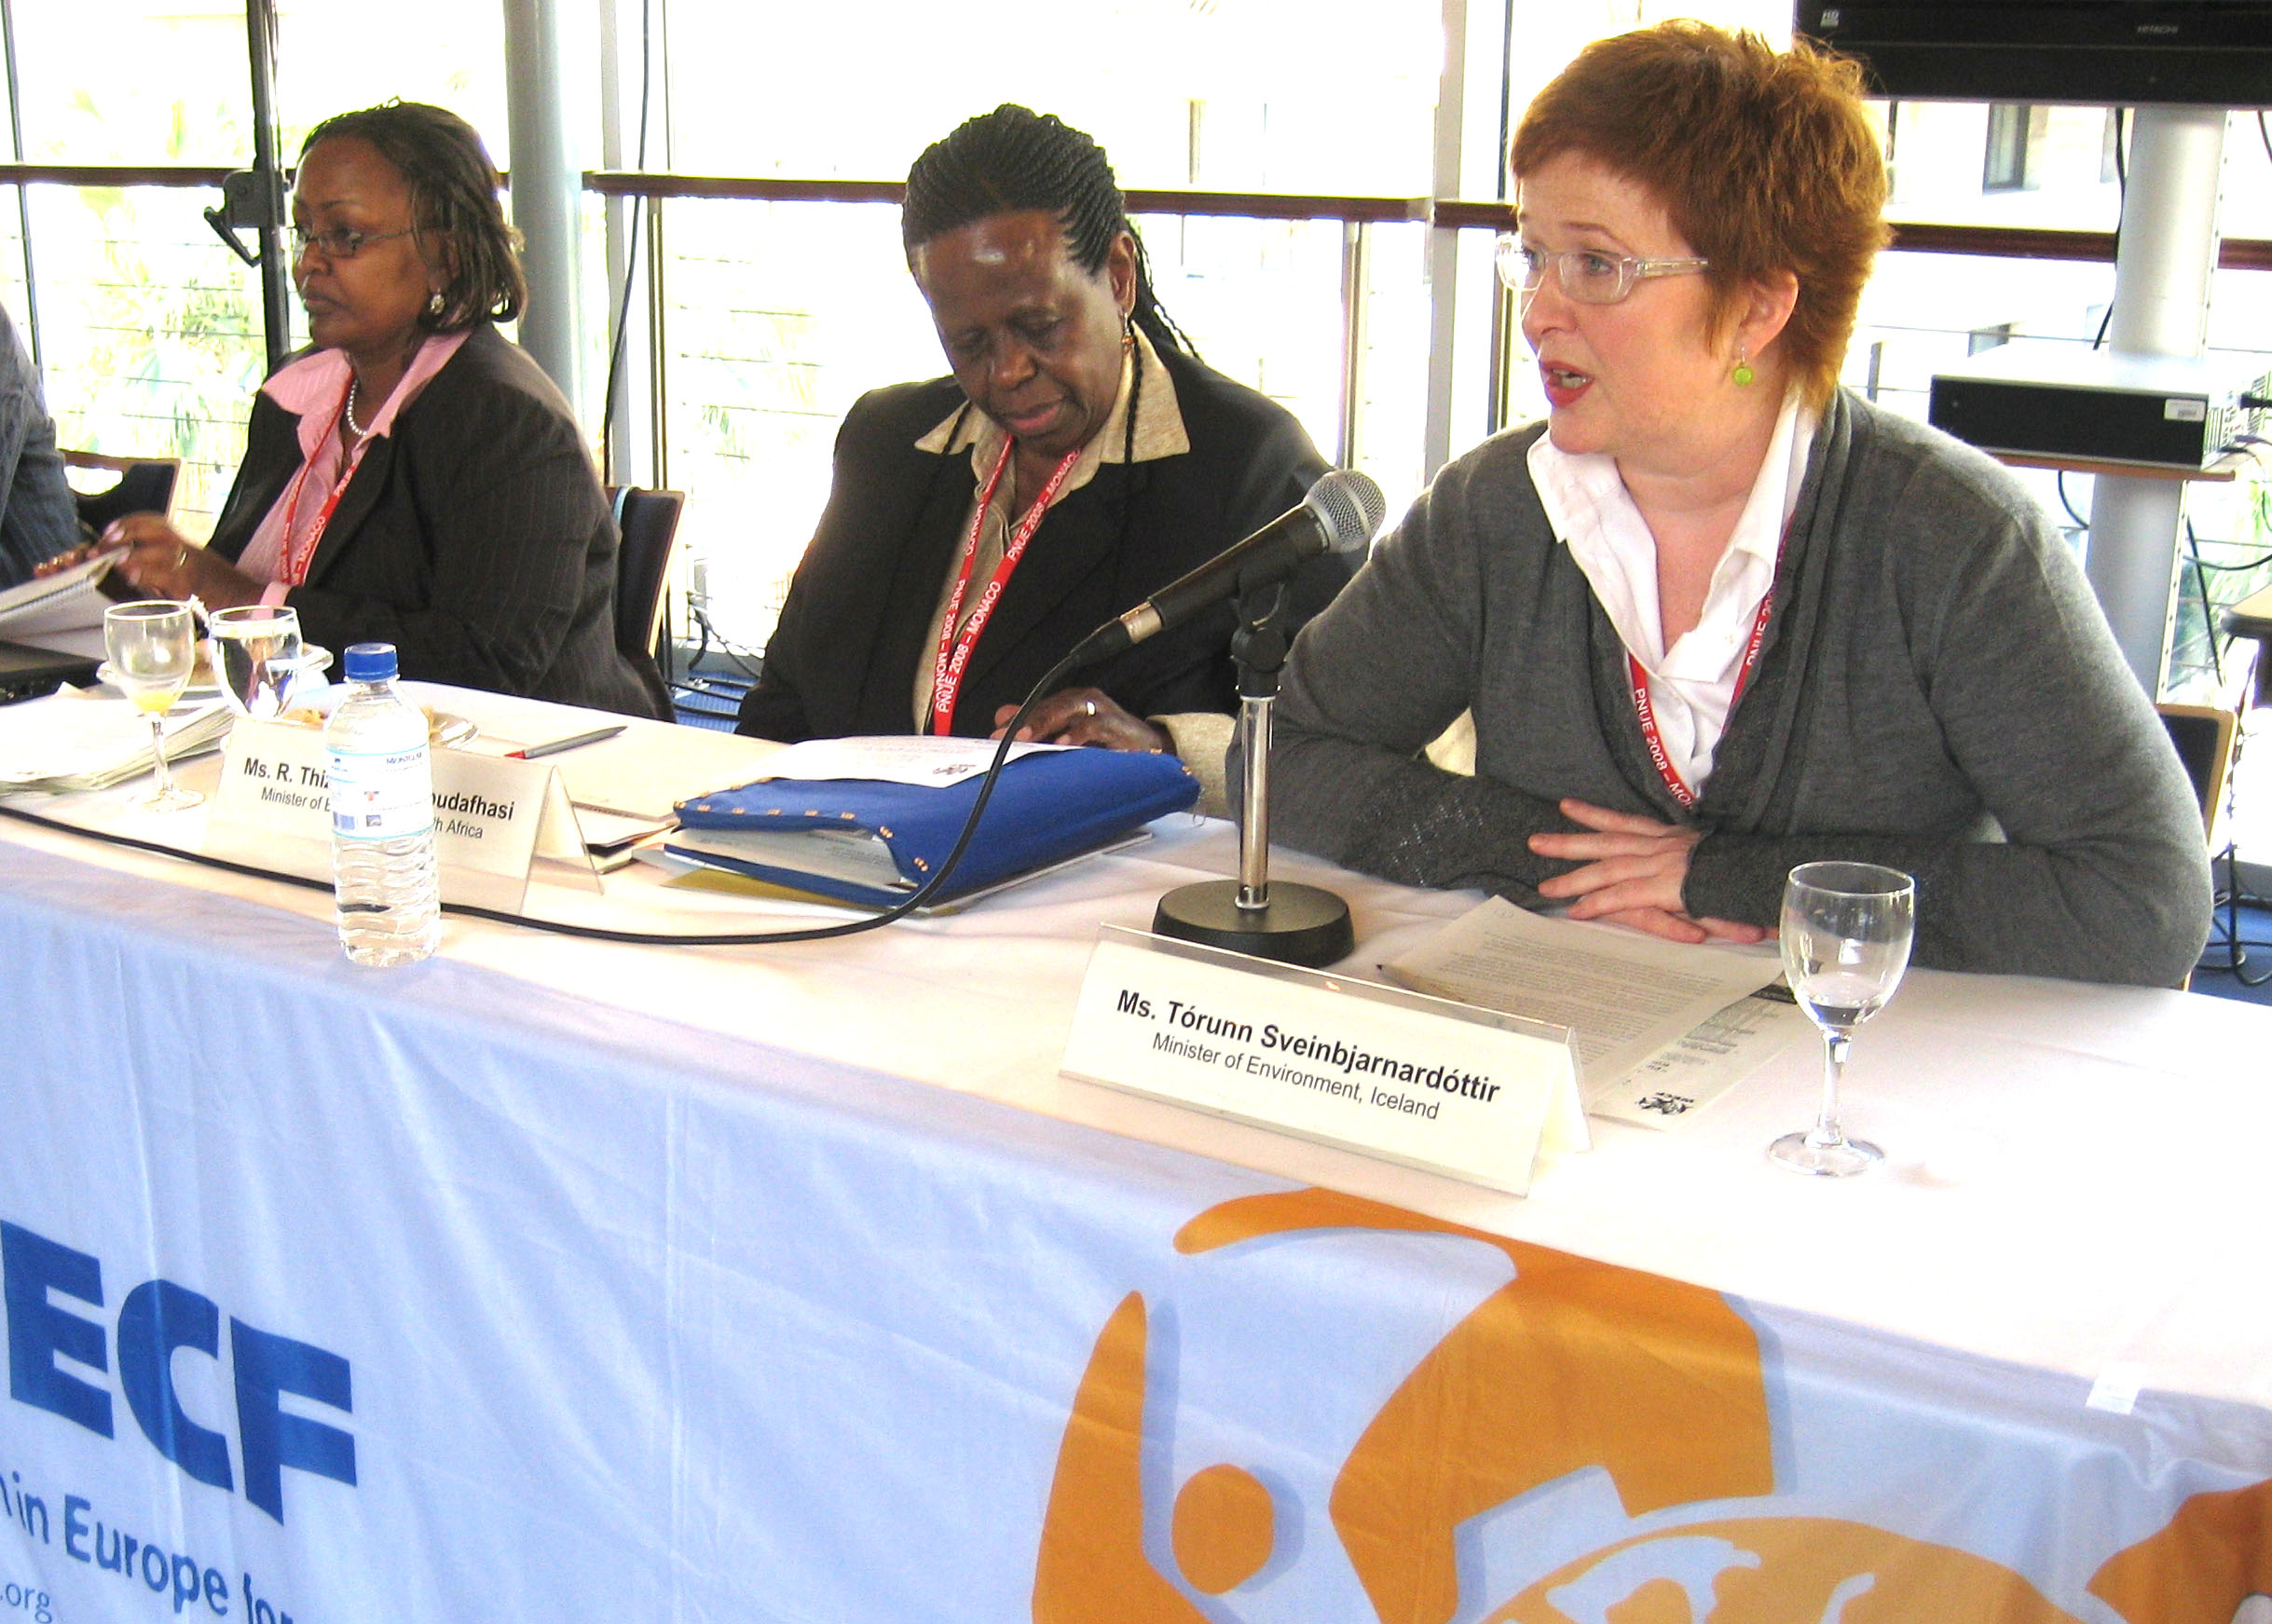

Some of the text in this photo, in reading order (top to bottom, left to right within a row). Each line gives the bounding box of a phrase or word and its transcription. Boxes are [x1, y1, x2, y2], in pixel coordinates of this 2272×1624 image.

[1007, 527, 1031, 561] PNUE
[950, 579, 966, 610] PNUE
[938, 676, 957, 714] PNUE
[949, 643, 969, 674] 2008
[966, 581, 1001, 635] MONACO
[244, 757, 270, 779] Ms.
[276, 762, 293, 783] R.
[1635, 687, 1653, 732] PNUE
[1646, 736, 1668, 771] 2008
[261, 785, 308, 808] Minister
[309, 796, 323, 810] of
[445, 819, 483, 839] Africa
[1116, 989, 1501, 1102] Ms. Tórunn Sveinbjarnardóttir
[1153, 1032, 1441, 1119] Minister of Environment, Iceland
[0, 1219, 358, 1526] ECF
[12, 1470, 49, 1545] in
[64, 1494, 228, 1617] Europe
